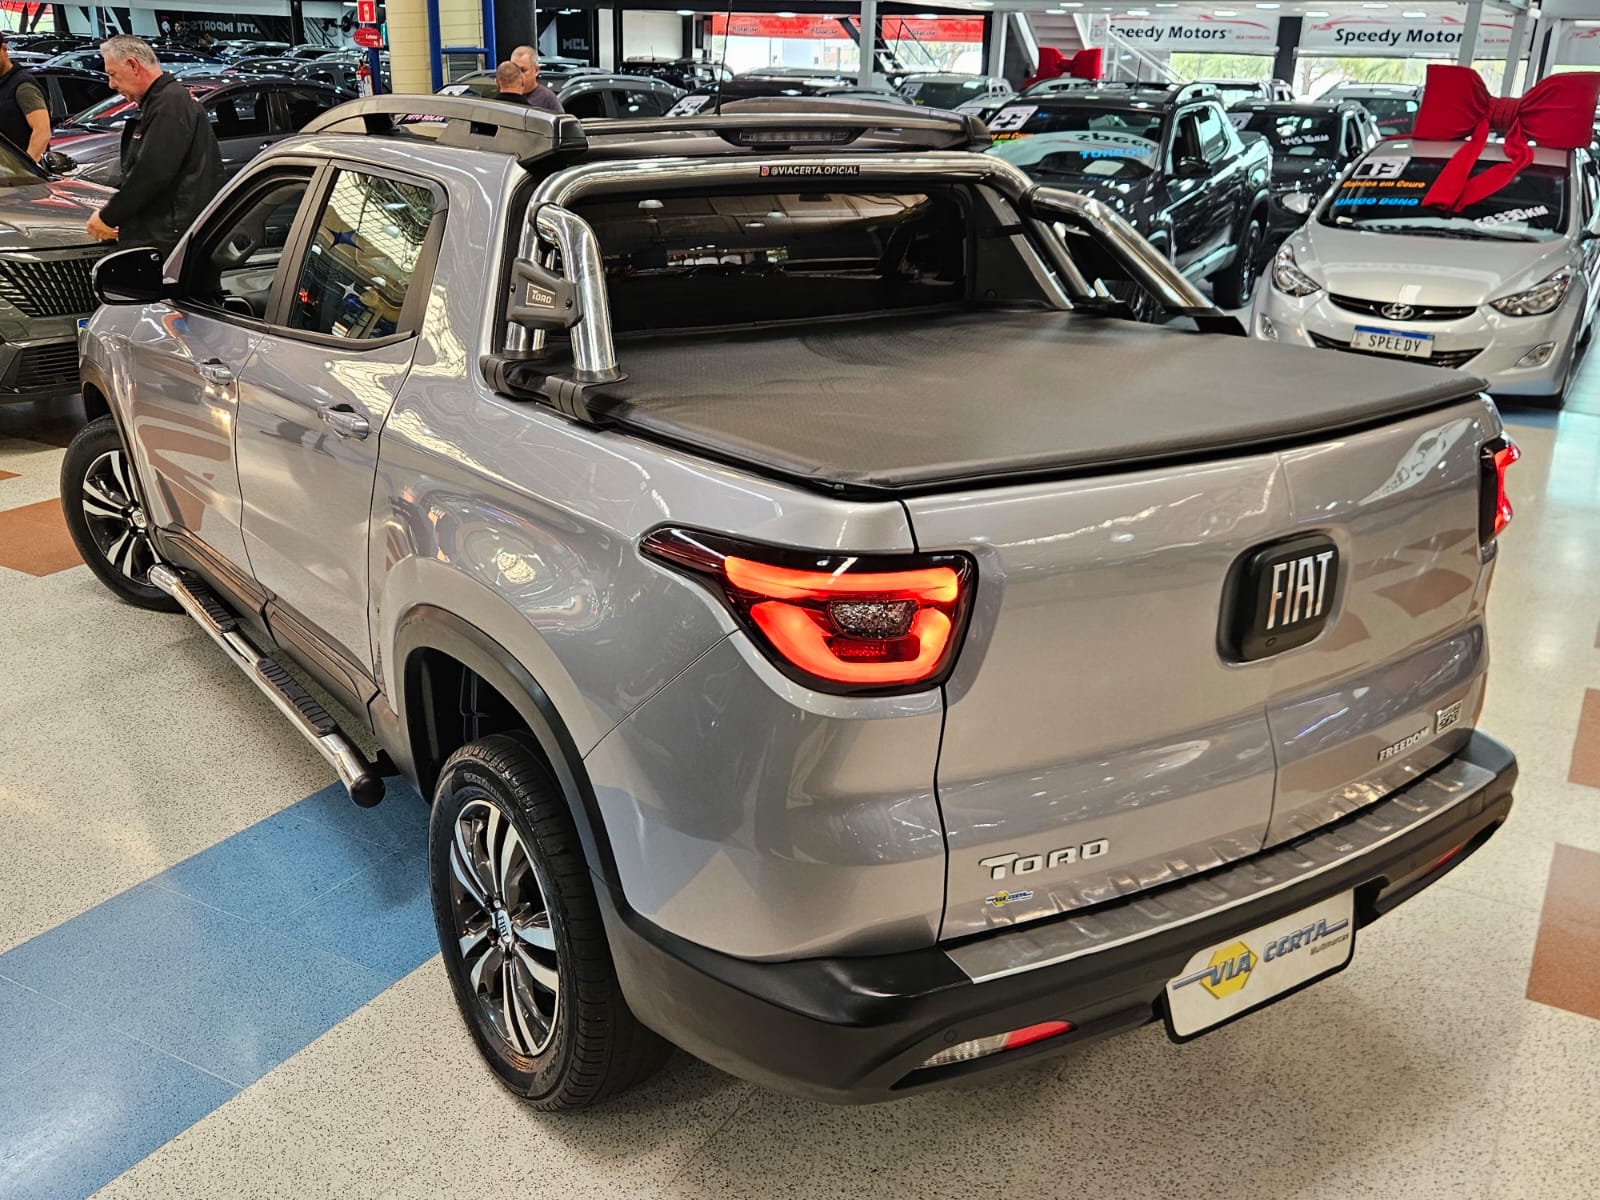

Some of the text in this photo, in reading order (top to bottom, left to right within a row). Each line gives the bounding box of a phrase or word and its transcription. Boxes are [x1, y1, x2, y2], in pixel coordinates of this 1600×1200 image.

[1168, 26, 1227, 40] Motors
[1334, 28, 1464, 46] Speedy Motor
[770, 166, 859, 176] @VIACERTA.OFICIAL
[532, 290, 552, 304] TORO
[1368, 334, 1421, 353] SPEEDY
[1266, 550, 1334, 630] FIAT
[1378, 726, 1430, 761] FREEDOM
[979, 838, 1109, 880] TORO
[498, 916, 509, 937] FIAT
[1203, 918, 1330, 987] VIA CERTA
